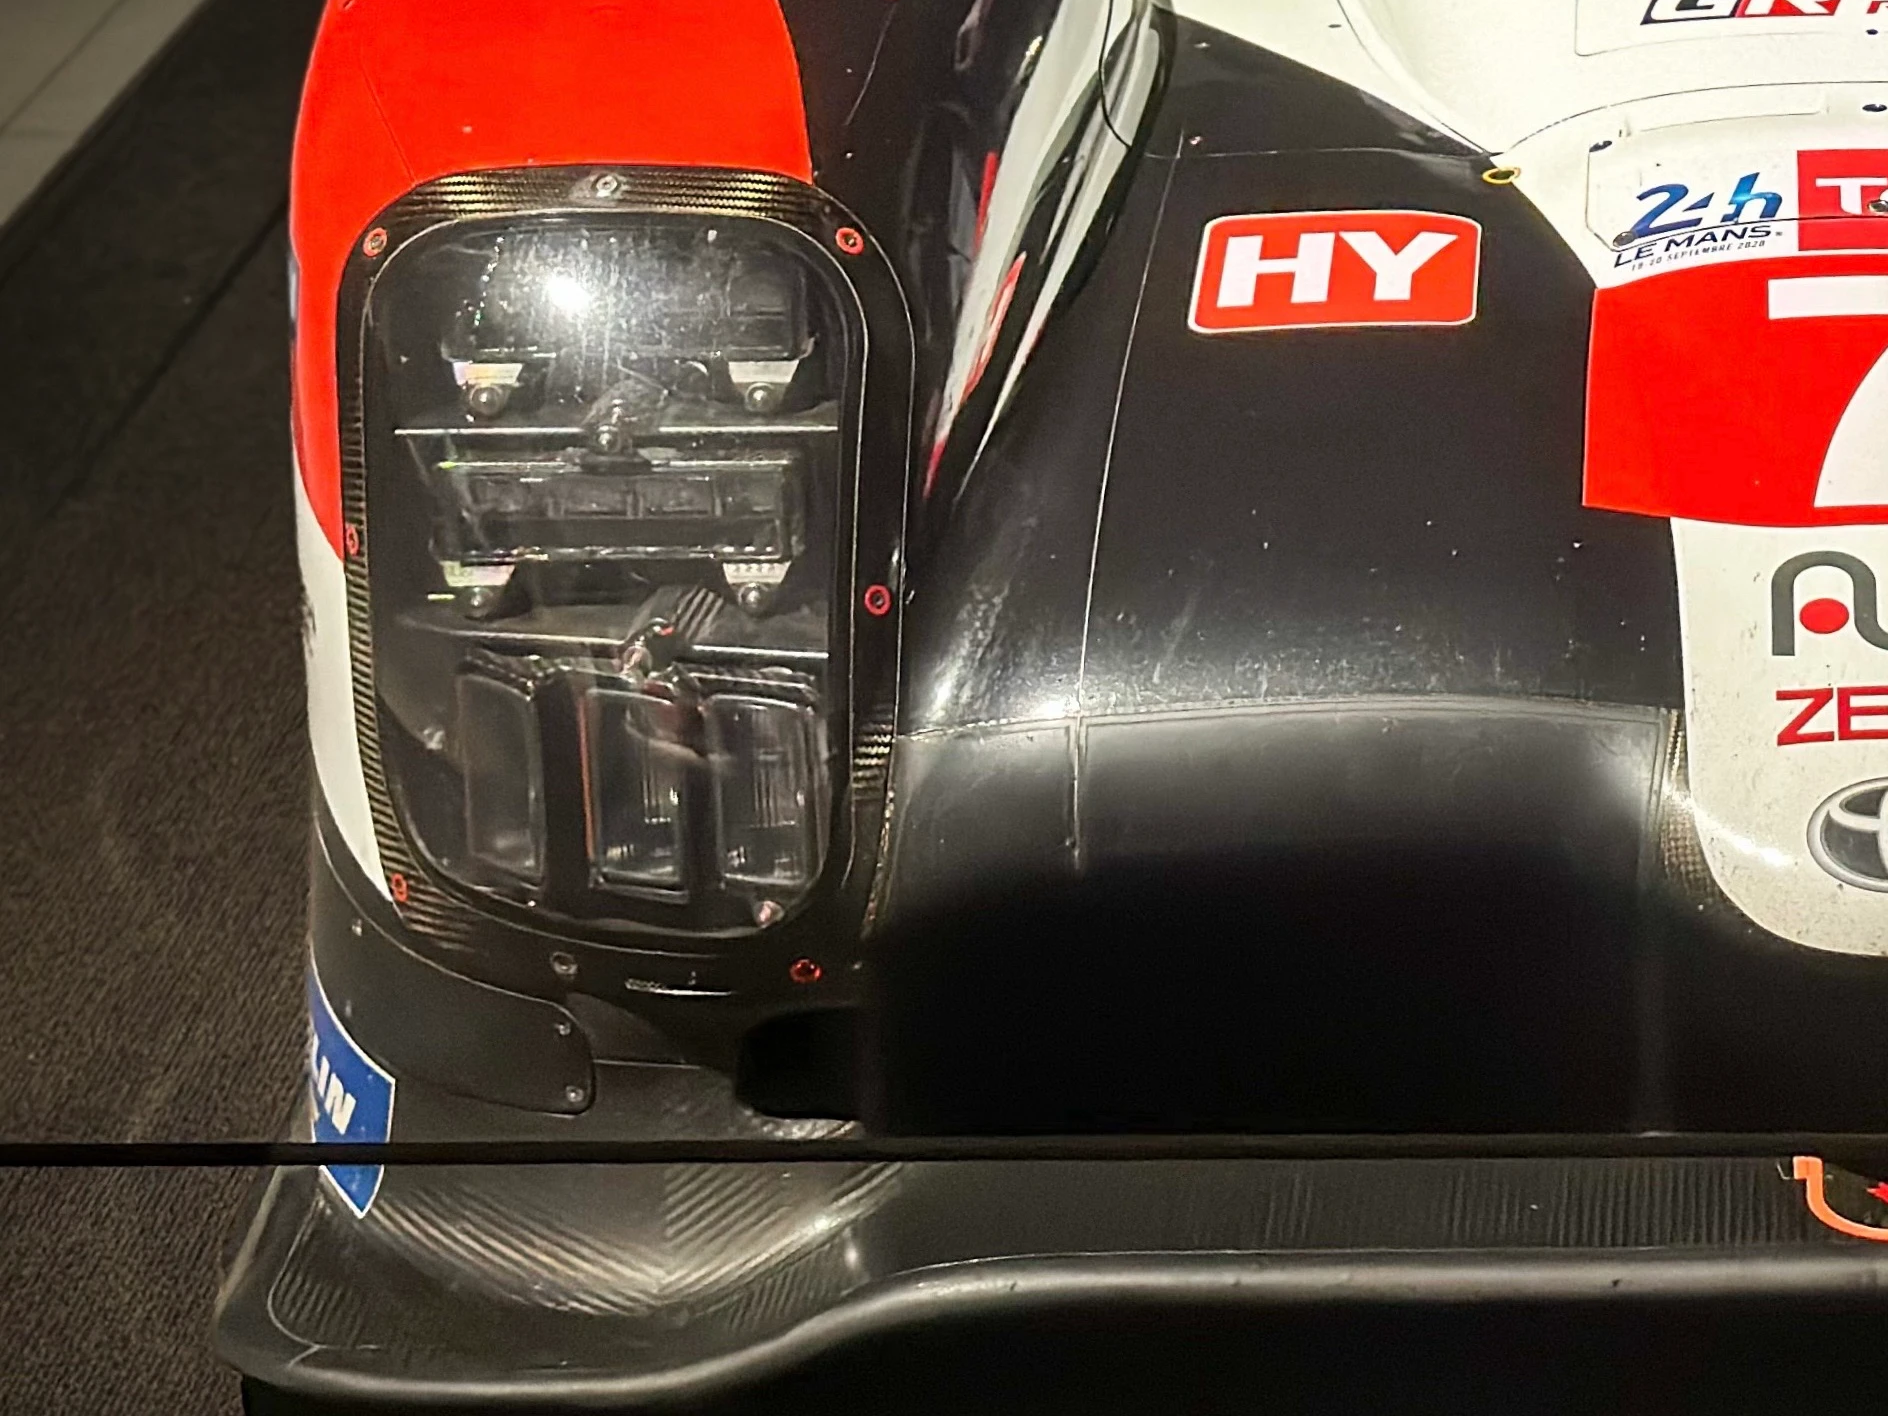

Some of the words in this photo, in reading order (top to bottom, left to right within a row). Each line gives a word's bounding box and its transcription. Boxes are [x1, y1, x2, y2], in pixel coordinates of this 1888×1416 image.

[1216, 230, 1462, 312] HY
[1614, 242, 1658, 269] LE
[1664, 224, 1772, 253] MANS
